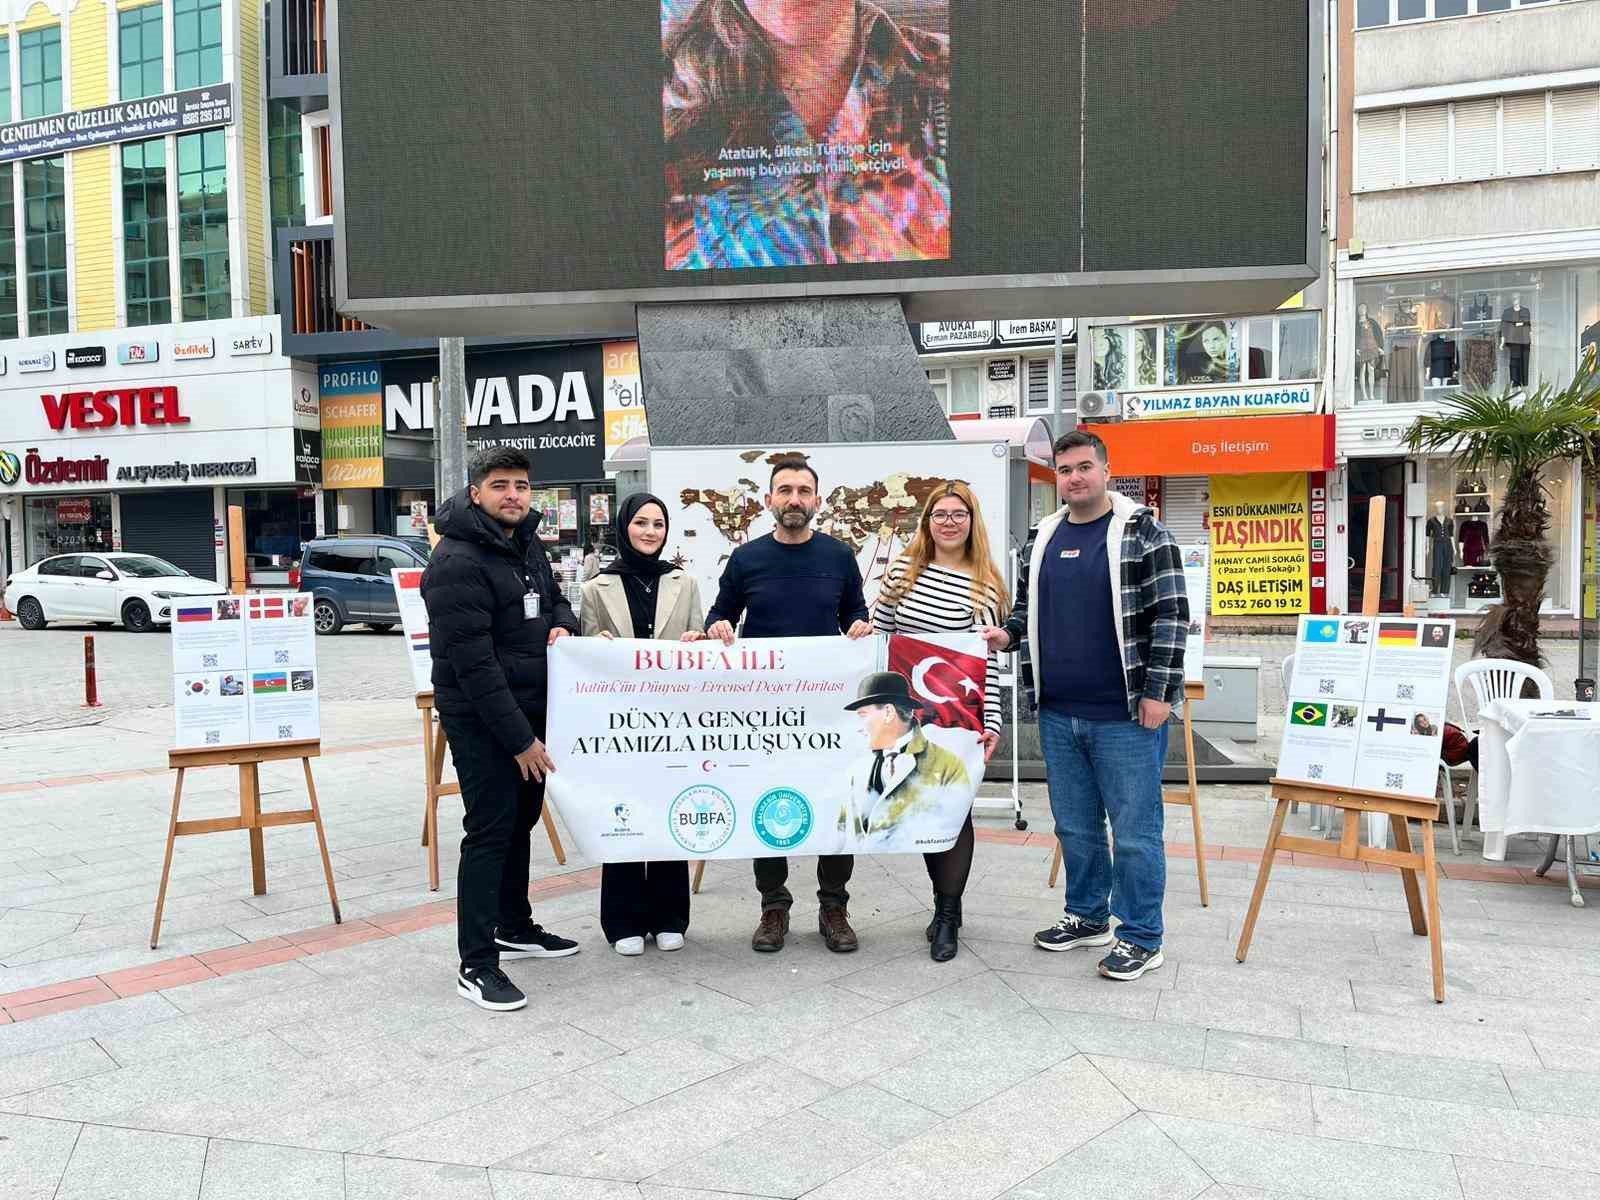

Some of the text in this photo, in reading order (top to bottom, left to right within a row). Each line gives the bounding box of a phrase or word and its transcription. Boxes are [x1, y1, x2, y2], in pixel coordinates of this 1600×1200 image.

[127, 97, 177, 121] SALONU
[719, 140, 892, 160] Atatürk, ülkesi Türkiye için
[704, 164, 755, 181] yaşamış
[759, 163, 800, 177] büyük
[803, 162, 820, 173] bir
[938, 320, 975, 332] AVUKAT
[1010, 321, 1056, 334] İrem BAŞKA
[233, 336, 263, 350] SAREV
[926, 330, 989, 342] Erman PAZARBAŞI
[1143, 388, 1310, 411] YILMAZ BAYAN KUAFÖRÜ
[40, 387, 190, 431] VESTEL
[499, 434, 537, 449] TEKSTİL
[539, 431, 596, 448] ZÜCCACİYE
[1192, 441, 1269, 456] Daş İletişim
[25, 447, 257, 485] Özdemir ALIŞVERİŞ MERKEZİ
[1236, 502, 1304, 516] DÜKKANIMIZA
[1212, 518, 1304, 548] TAŞINDIK
[1214, 558, 1243, 566] HANAY
[1271, 554, 1305, 563] SOKAĞI
[1224, 565, 1246, 574] Pazar
[1248, 565, 1265, 573] Yeri
[1266, 564, 1296, 573] Sokağı
[1217, 581, 1243, 595] DAŞ
[1219, 597, 1302, 609] 0532 760 19 12
[635, 646, 785, 671] BUBFA İLE
[640, 680, 691, 695] Dünyası
[701, 678, 752, 694] Evrensel
[794, 678, 846, 693] Haritası
[608, 706, 806, 731] DÜNYA GENÇLİĞİ
[571, 732, 843, 755] ATAMIZLA BULUŞUYOR
[679, 812, 726, 826] BUBFA
